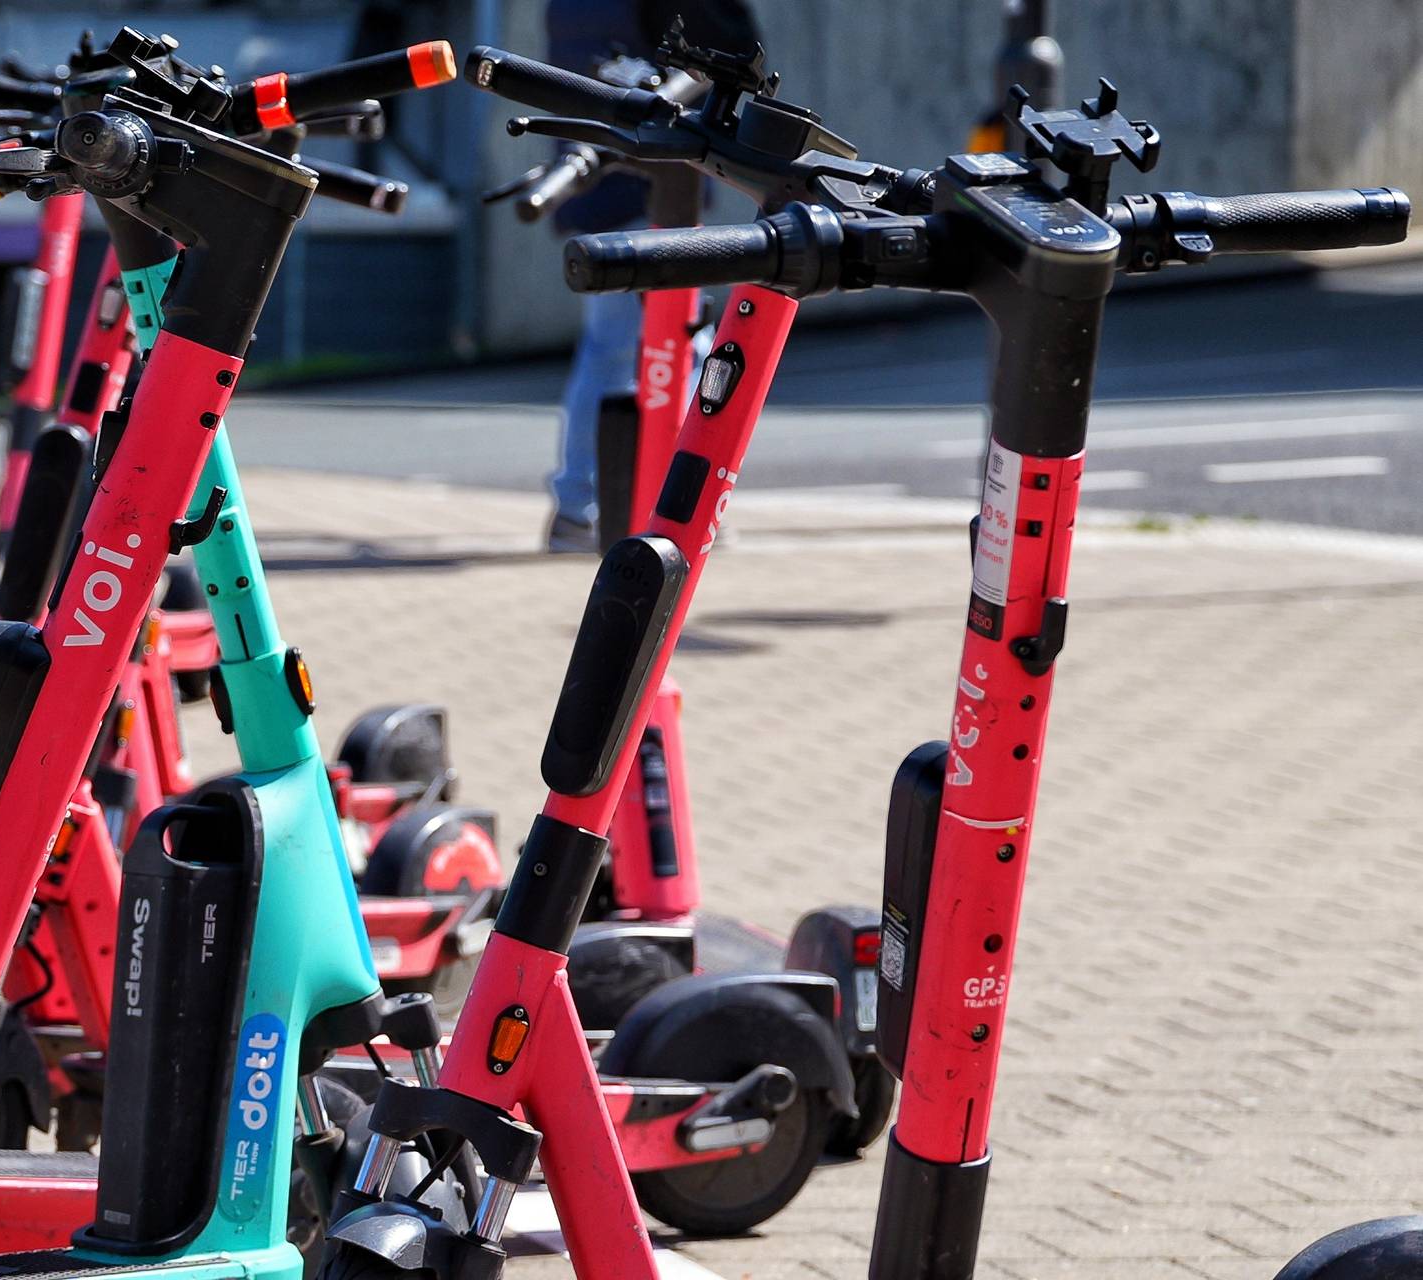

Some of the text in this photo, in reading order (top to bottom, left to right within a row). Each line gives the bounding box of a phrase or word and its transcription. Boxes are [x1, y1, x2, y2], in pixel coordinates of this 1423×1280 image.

[643, 339, 676, 411] voi.
[63, 533, 141, 647] voi.
[124, 897, 151, 1017] Swap!
[201, 903, 217, 963] TIER
[239, 1031, 279, 1130] dott
[230, 1140, 250, 1201] TIER
[250, 1142, 260, 1163] now
